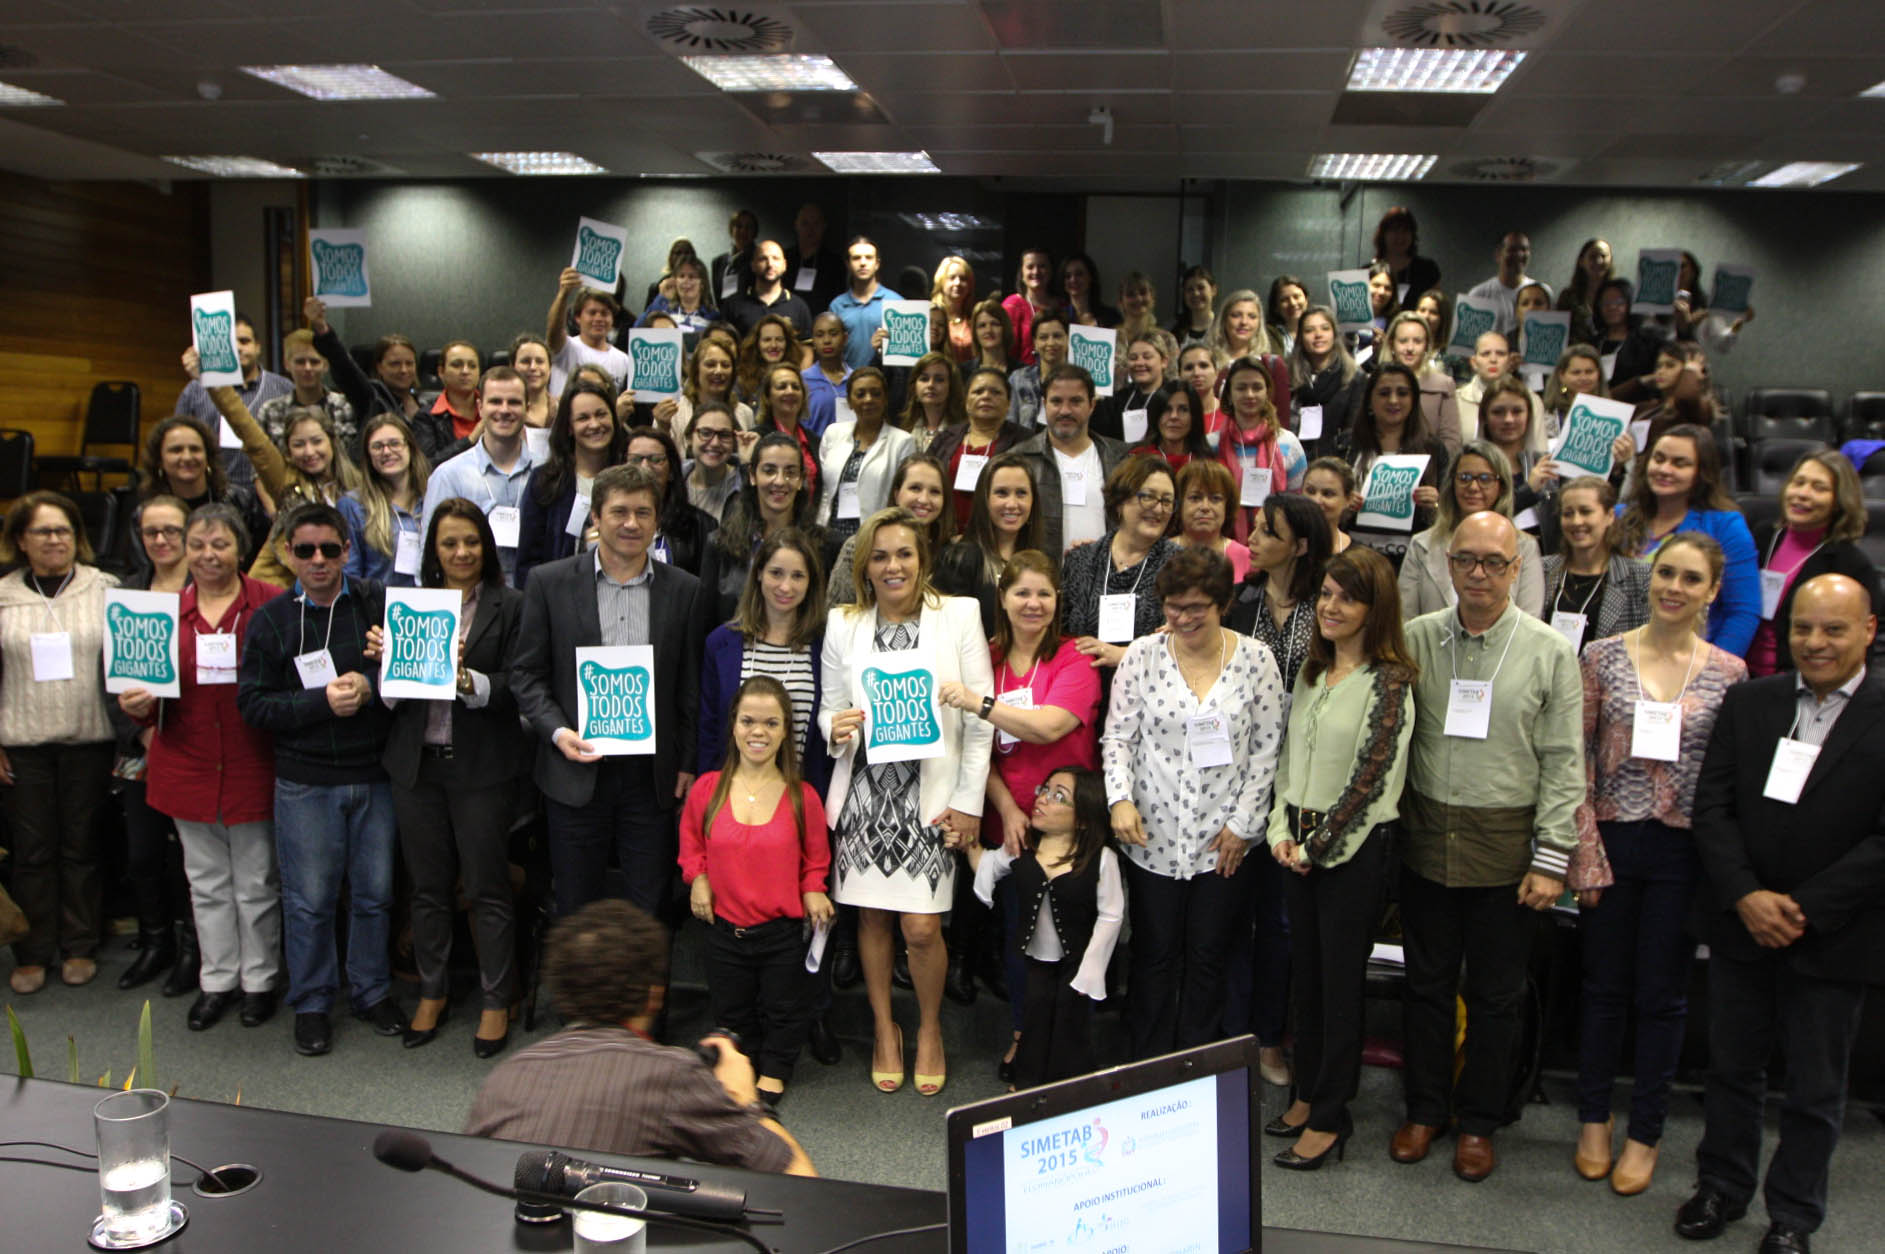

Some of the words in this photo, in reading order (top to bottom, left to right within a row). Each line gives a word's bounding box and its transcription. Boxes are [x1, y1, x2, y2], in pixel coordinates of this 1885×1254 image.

[582, 248, 613, 269] TODOS
[200, 333, 230, 353] TODOS
[890, 328, 923, 344] TODOS
[889, 342, 923, 354] GIGANTES
[637, 359, 673, 377] TODOS
[635, 375, 673, 389] GIGANTES
[1569, 429, 1611, 456] TODOS
[1561, 447, 1604, 469] GIGANTES
[1370, 480, 1410, 502] TODOS
[1366, 499, 1406, 513] GIGANTES
[114, 634, 166, 663] TODOS
[395, 635, 446, 662] TODOS
[114, 660, 168, 679] GIGANTES
[392, 661, 447, 679] GIGANTES
[589, 694, 643, 719] TODOS
[874, 698, 928, 725] TODOS
[590, 718, 645, 736] GIGANTES
[875, 721, 932, 743] GIGANTES
[1020, 1124, 1093, 1159] SIMETAB
[1037, 1149, 1078, 1175] 2015
[1073, 1196, 1101, 1212] APOIO
